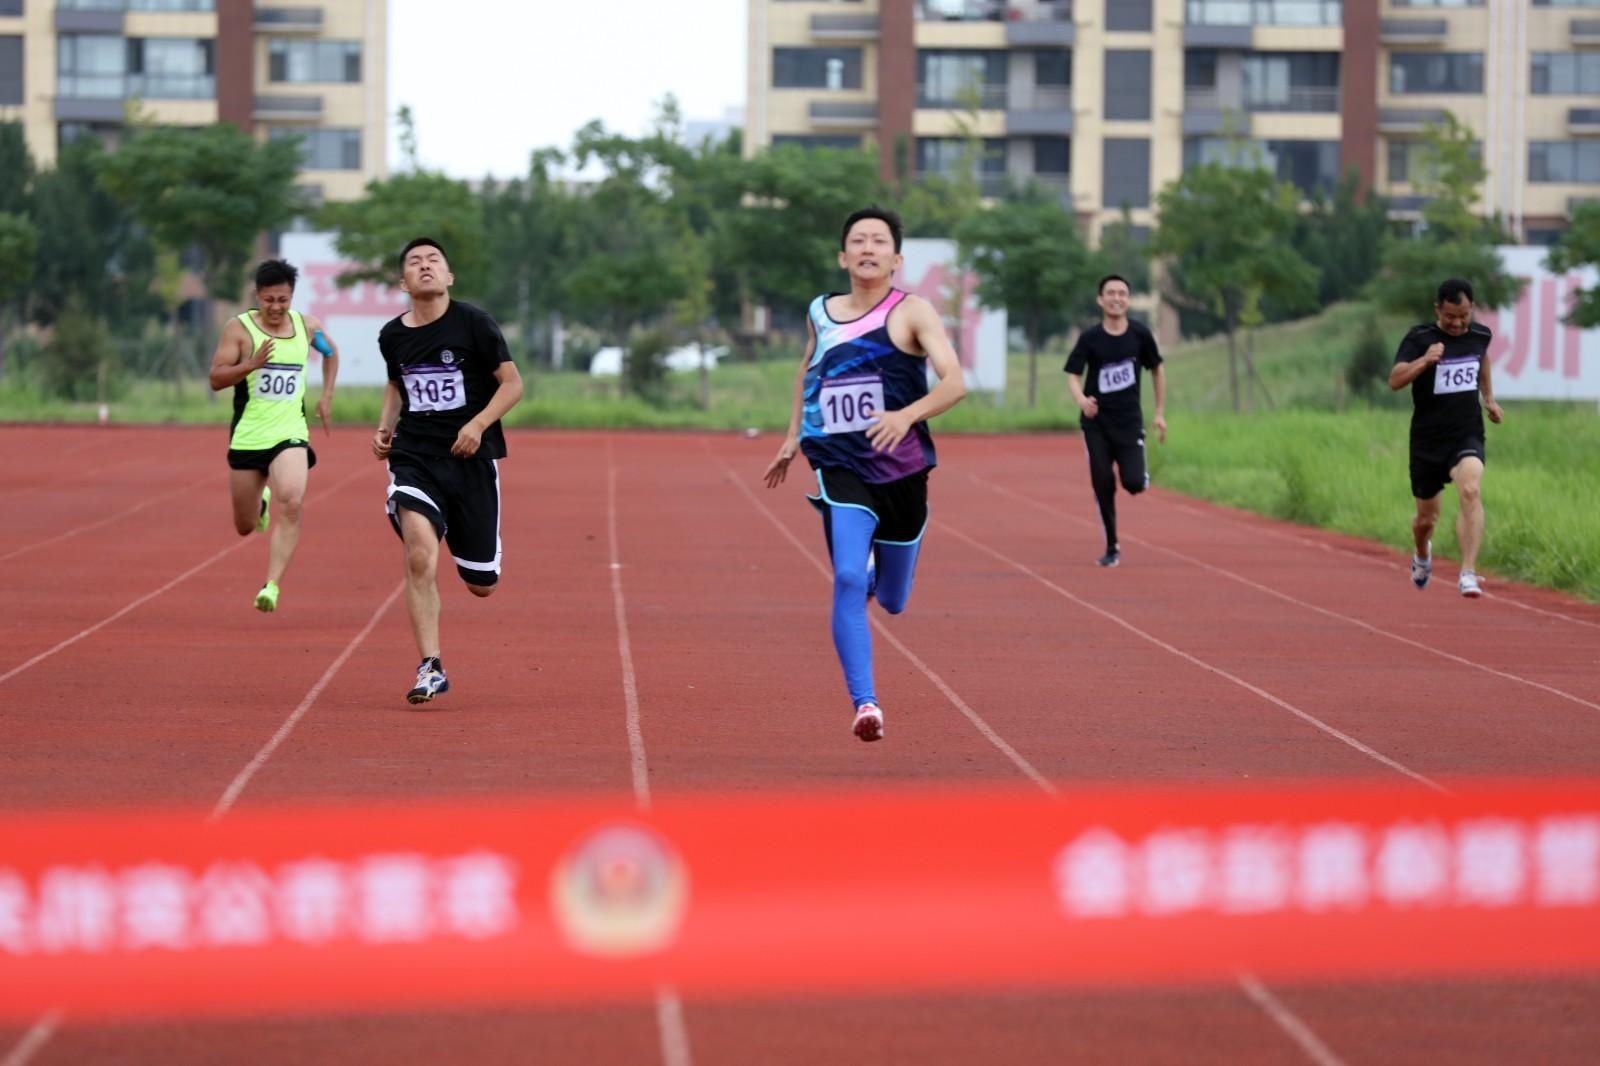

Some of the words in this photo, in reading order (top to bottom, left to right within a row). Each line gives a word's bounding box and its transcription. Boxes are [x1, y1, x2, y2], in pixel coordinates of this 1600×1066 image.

[259, 373, 296, 395] 306
[1442, 367, 1475, 387] 165
[412, 378, 456, 404] 105
[827, 391, 875, 423] 106
